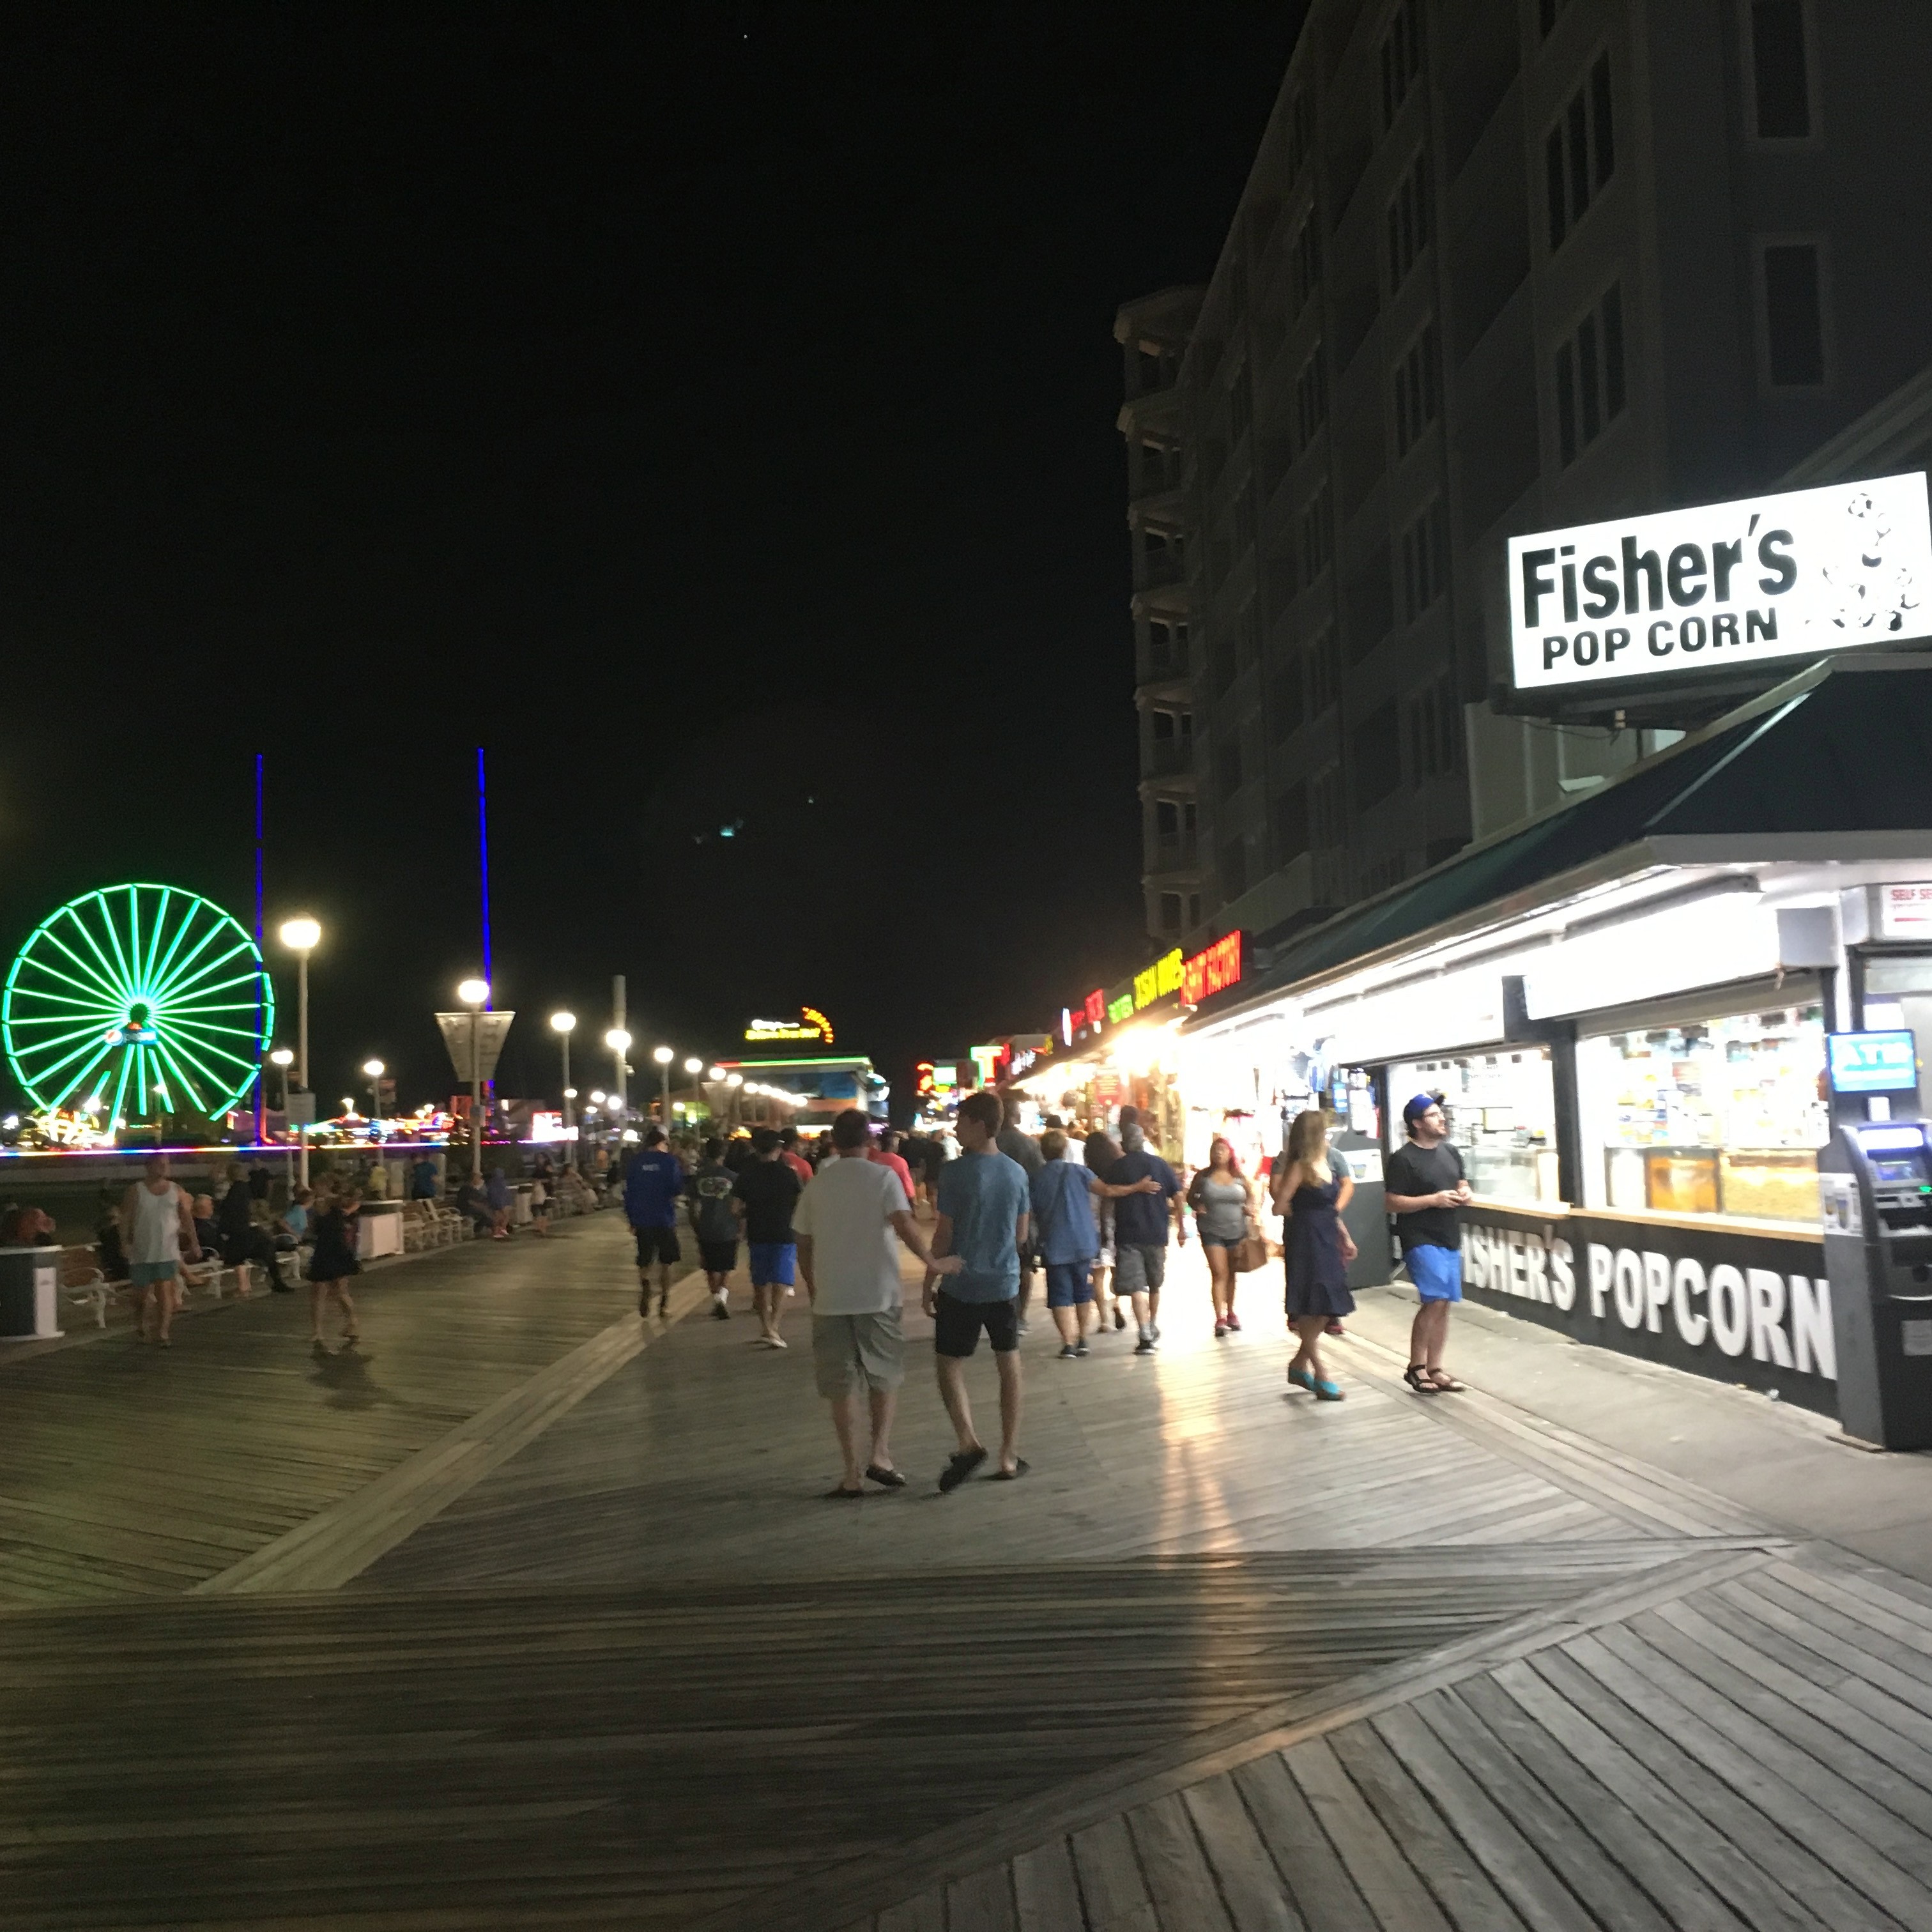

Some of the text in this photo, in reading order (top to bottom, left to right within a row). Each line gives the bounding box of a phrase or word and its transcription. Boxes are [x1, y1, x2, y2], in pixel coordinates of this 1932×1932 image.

[1522, 514, 1798, 629] Fisher's
[1542, 607, 1779, 670] POP CORN
[1460, 1223, 1837, 1381] ISHER'S POPCORN
